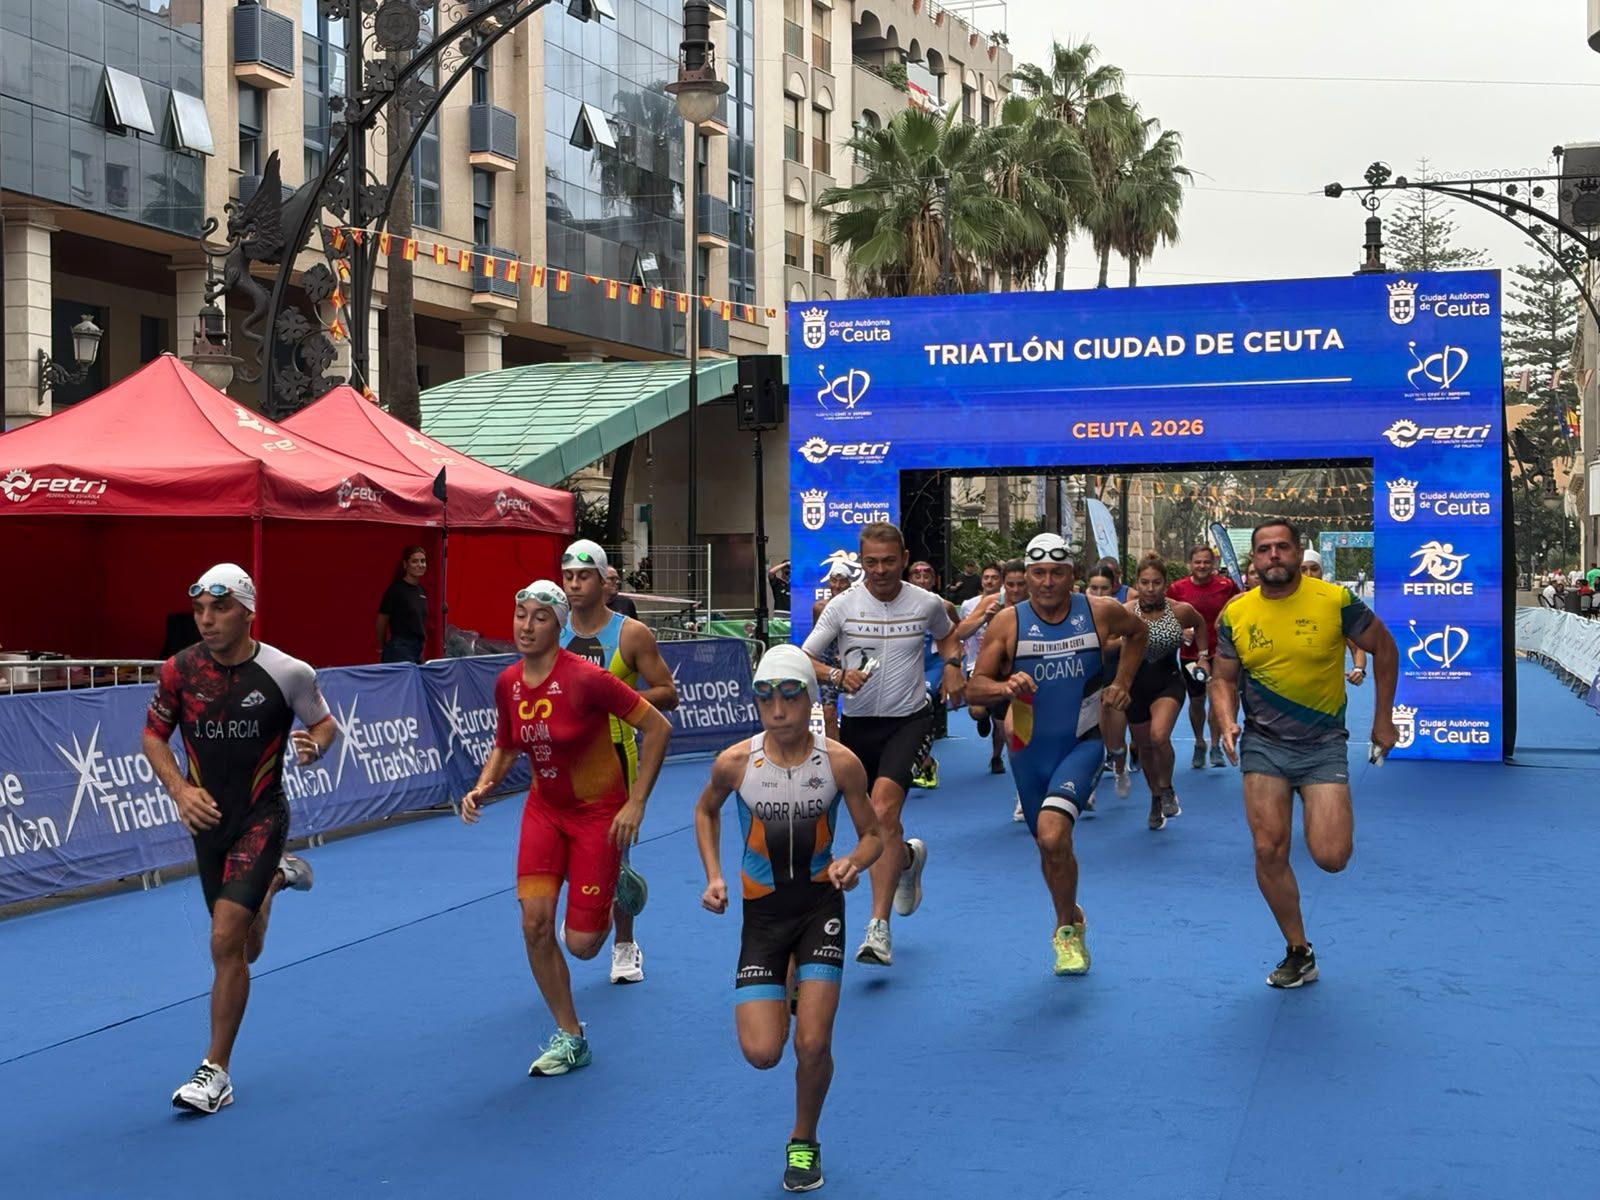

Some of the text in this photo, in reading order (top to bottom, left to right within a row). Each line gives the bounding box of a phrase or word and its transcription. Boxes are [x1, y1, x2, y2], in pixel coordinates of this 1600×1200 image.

[1434, 301, 1490, 317] Ceuta
[842, 328, 890, 342] Ceuta
[924, 328, 1345, 366] TRIATLÓN CIUDAD DE CEUTA
[1071, 419, 1204, 439] CEUTA 2026
[1420, 492, 1447, 500] Ciudad
[1435, 500, 1490, 516] Ceuta
[842, 510, 890, 524] Ceuta
[1403, 582, 1474, 596] FETRICE
[858, 625, 879, 633] VAN
[1034, 656, 1085, 682] OCAÑA
[195, 720, 203, 738] J.
[351, 716, 419, 748] Europe
[1434, 728, 1490, 743] Ceuta
